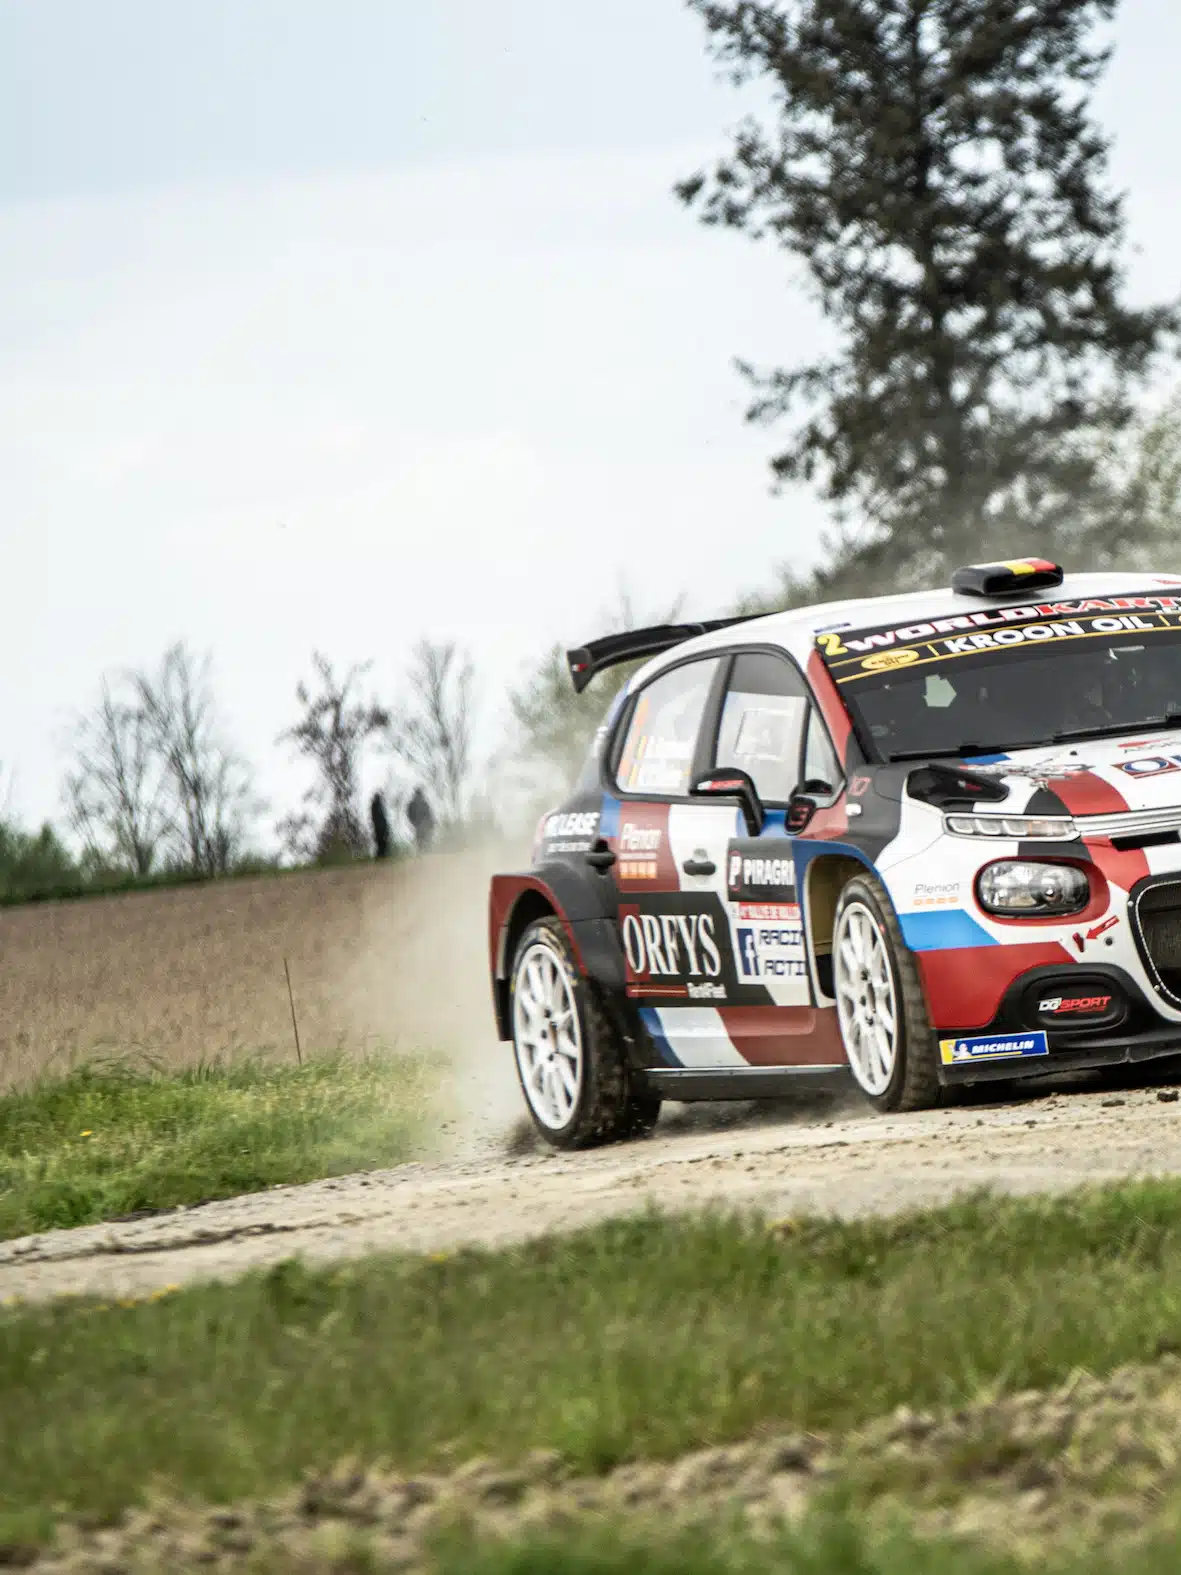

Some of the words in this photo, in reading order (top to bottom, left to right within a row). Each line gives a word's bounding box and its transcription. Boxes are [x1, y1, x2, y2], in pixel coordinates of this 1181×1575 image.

[817, 633, 848, 656] 2
[944, 621, 1085, 653] KROON
[1092, 616, 1153, 632] OIL
[623, 914, 721, 977] ORFYS
[971, 1039, 1035, 1055] MICHELIN
